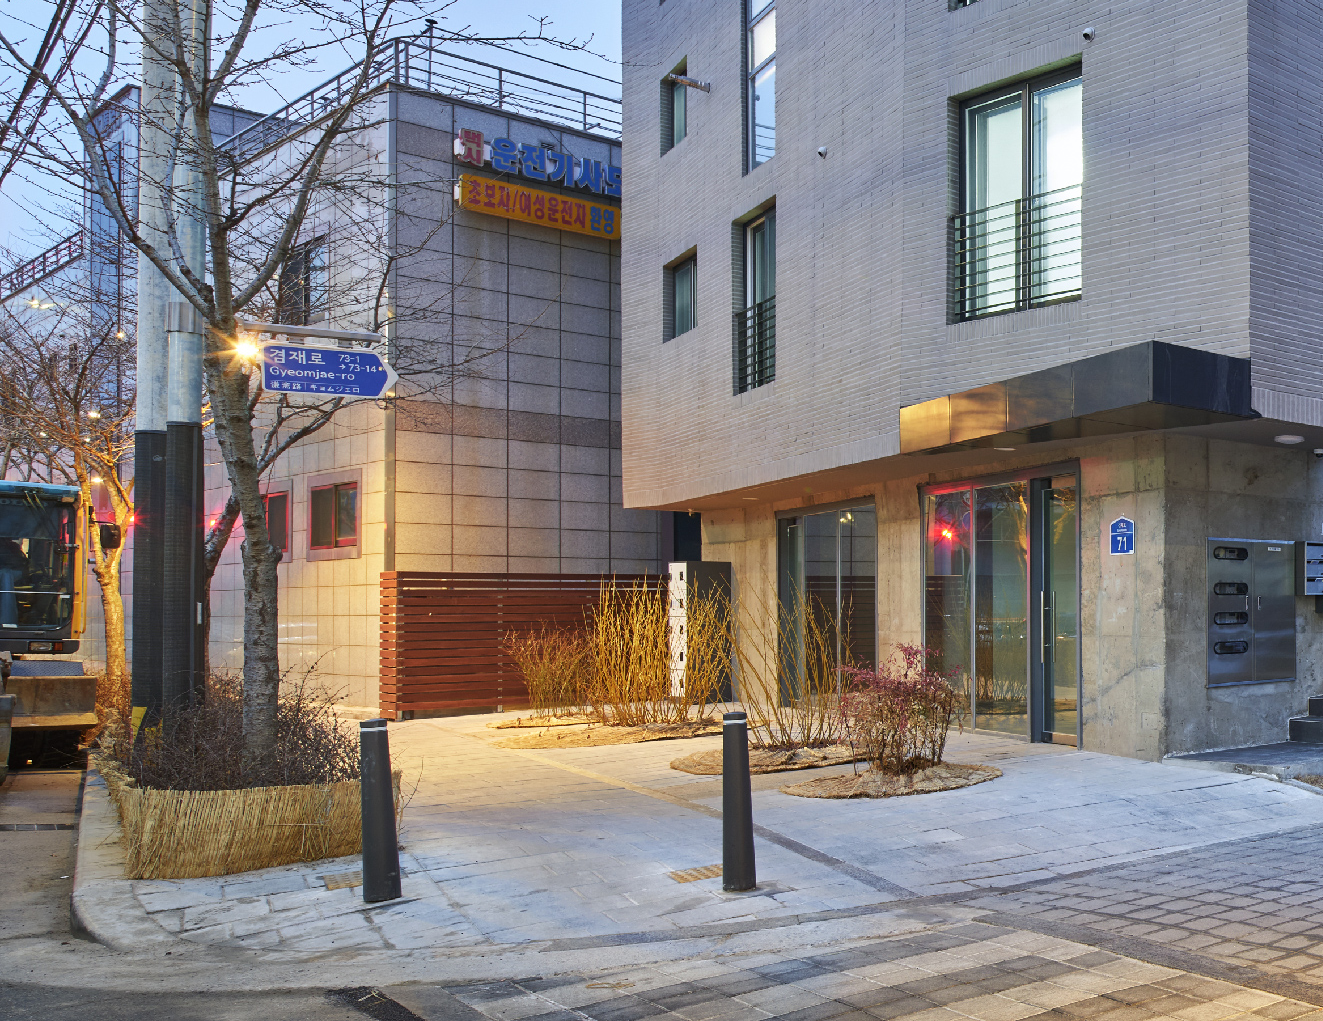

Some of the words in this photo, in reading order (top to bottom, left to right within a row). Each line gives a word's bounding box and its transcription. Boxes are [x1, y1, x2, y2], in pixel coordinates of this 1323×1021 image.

[590, 206, 615, 235] 환영
[269, 348, 326, 365] 겸재로
[338, 354, 360, 363] 73-1
[269, 366, 355, 381] Gyeomjae-ro
[348, 364, 377, 373] 73-14
[1116, 536, 1127, 551] 71
